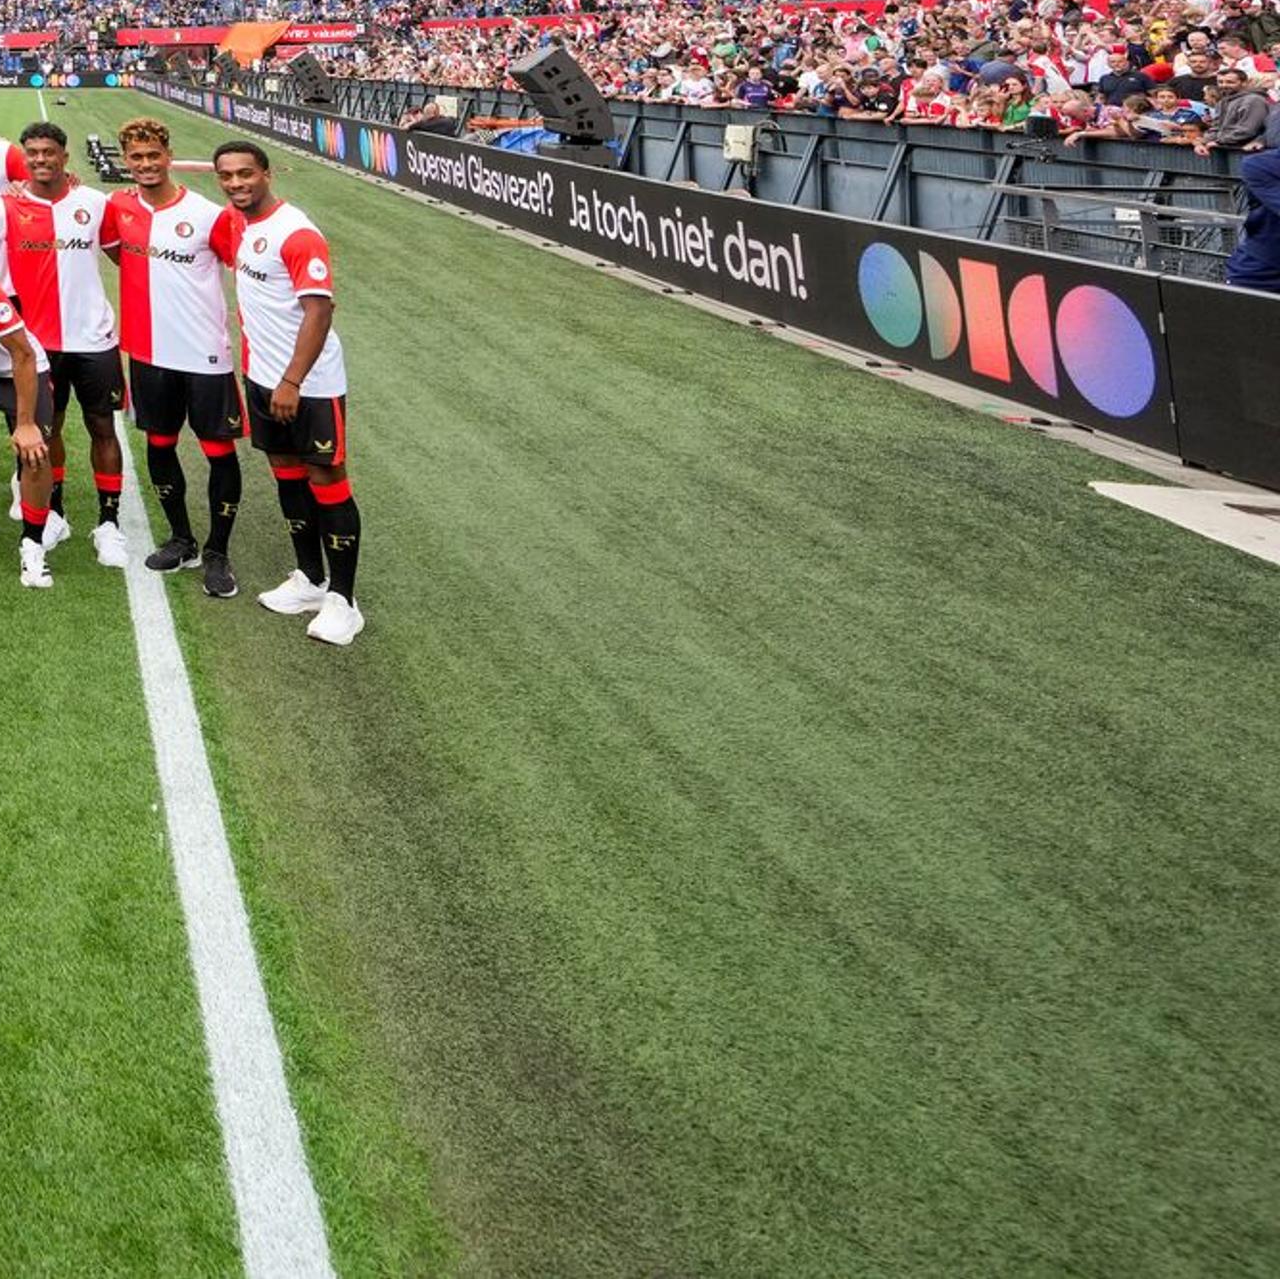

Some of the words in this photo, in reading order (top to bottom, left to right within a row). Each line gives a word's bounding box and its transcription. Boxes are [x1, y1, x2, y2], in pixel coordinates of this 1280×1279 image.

[158, 249, 196, 265] Markt
[406, 140, 467, 188] Supersnel
[467, 154, 554, 217] Glasvezel?
[569, 180, 592, 233] Ja
[592, 189, 657, 260] toch,
[659, 206, 719, 273] niet
[723, 220, 808, 301] dan!
